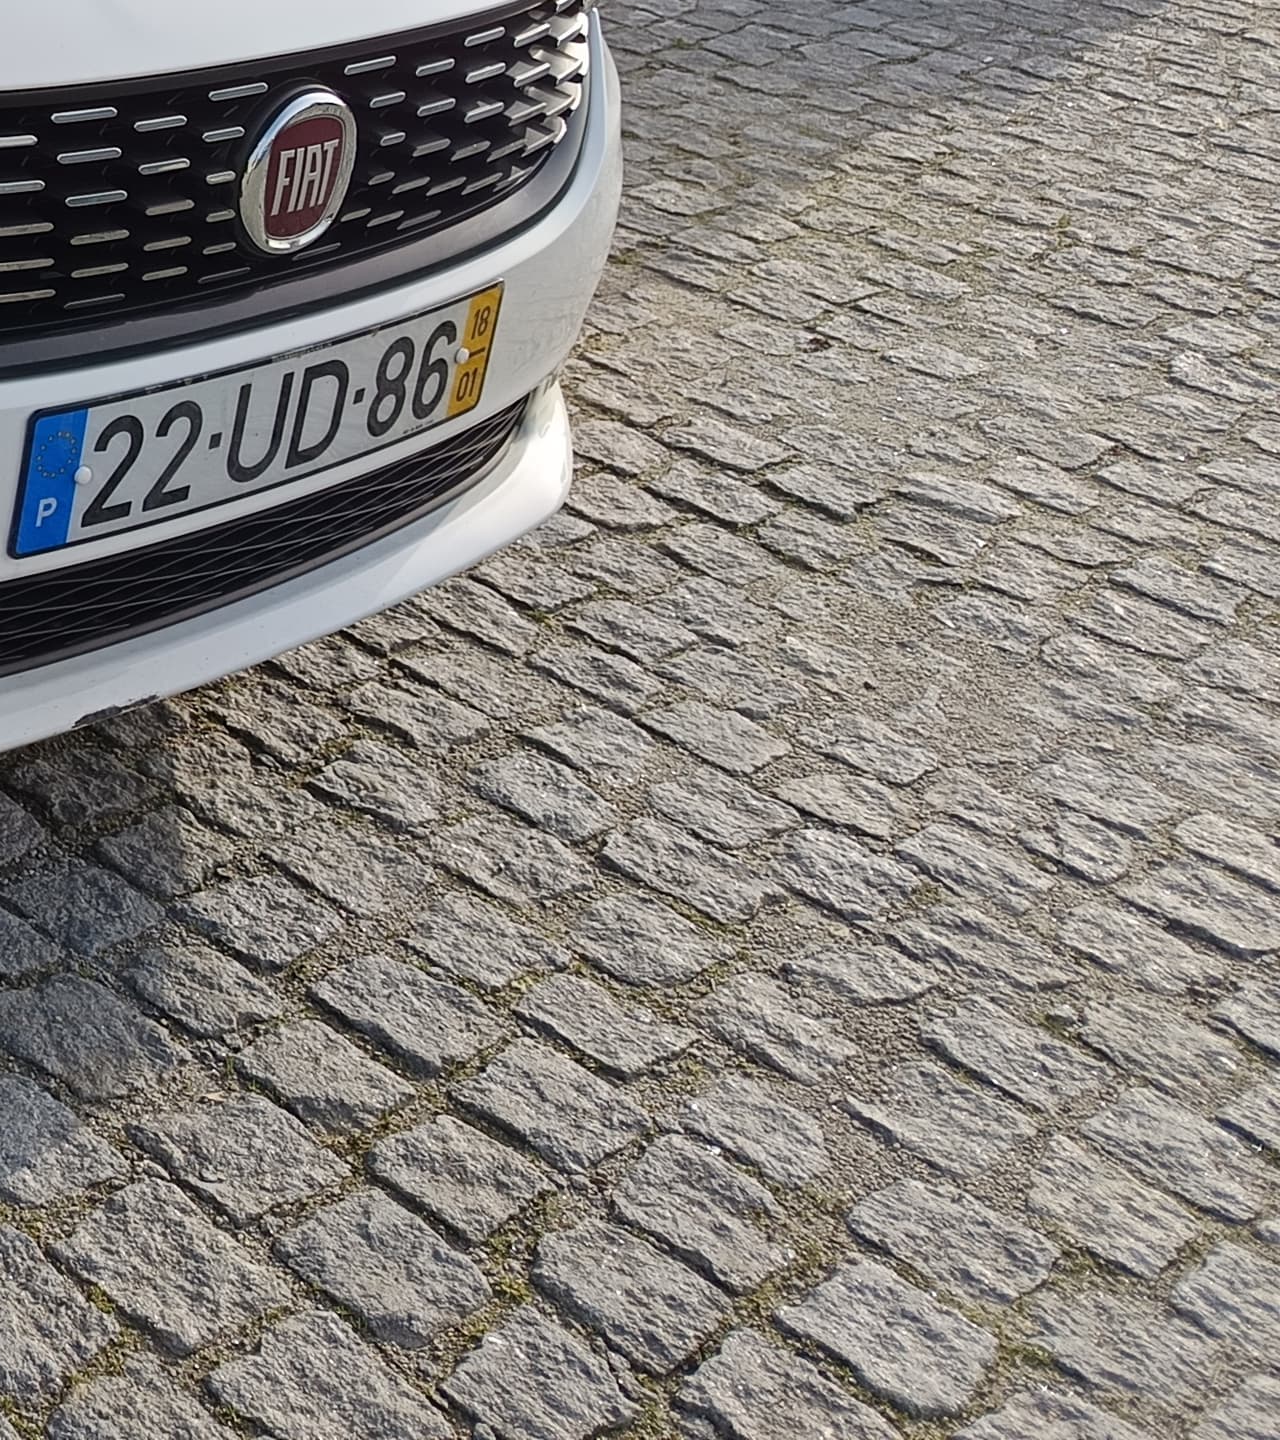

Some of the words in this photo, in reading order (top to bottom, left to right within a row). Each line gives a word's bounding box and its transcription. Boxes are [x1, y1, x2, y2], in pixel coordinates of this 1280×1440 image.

[270, 138, 340, 218] FIAT
[471, 305, 491, 340] 18
[456, 367, 479, 402] 01
[35, 497, 58, 528] P
